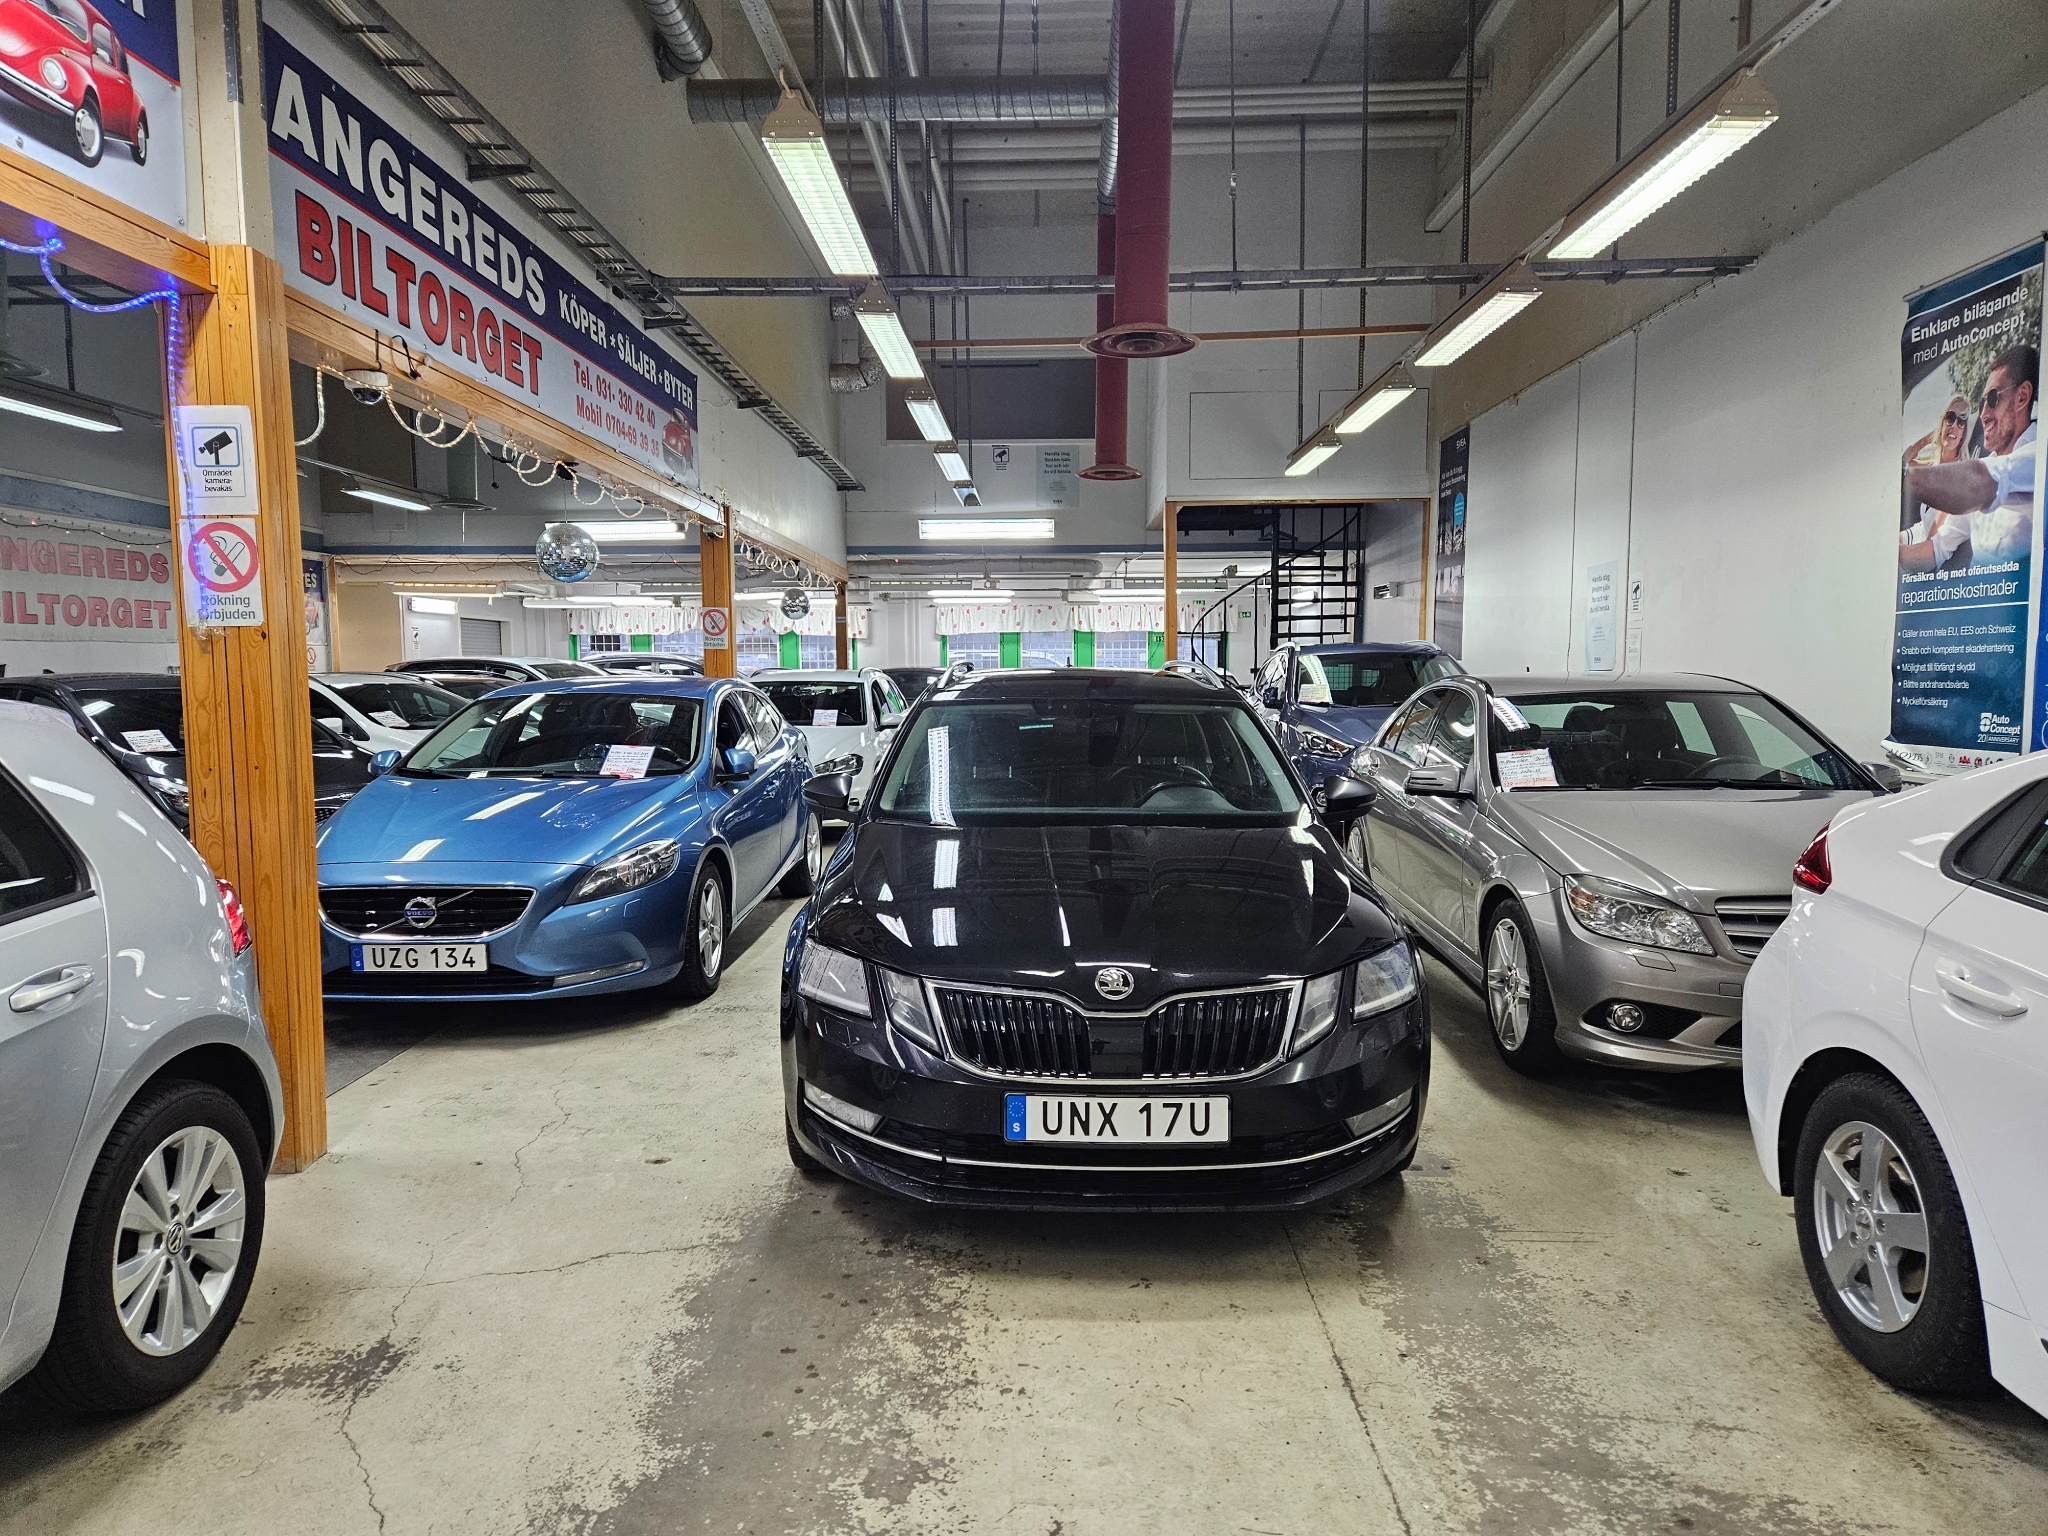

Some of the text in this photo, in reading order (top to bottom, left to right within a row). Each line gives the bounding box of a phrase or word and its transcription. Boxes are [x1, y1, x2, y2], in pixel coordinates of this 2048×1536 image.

[270, 64, 693, 411] ANGEREDS KÖPER SÄLJER BYTER
[294, 188, 543, 397] BILTORGET
[1911, 287, 2029, 343] Enklare bilägande
[1913, 311, 2025, 365] med AutoConcept
[573, 359, 593, 392] Tel.
[618, 388, 633, 416] 330
[634, 399, 645, 423] 42
[647, 407, 656, 430] 40
[576, 395, 660, 459] Mobil 0704-69 39 35
[202, 469, 233, 477] Området
[204, 484, 233, 492] bevakas
[0, 535, 170, 584] NGEREDS
[1901, 561, 2020, 584] Försäkra dig mot oförutsedda
[1901, 580, 2018, 606] reparationskostnader
[0, 590, 172, 629] ILTORGET
[1902, 623, 2017, 638] Gäller inom hela EU, EES och Schweiz
[1901, 643, 2015, 655] Snabb och kompetent skadehantering
[1901, 663, 1927, 673] Möjlighet
[1934, 662, 1956, 673] förlängt
[1956, 662, 1976, 673] skydd
[1903, 680, 1970, 689] Bättre andrahandsvärde
[1902, 696, 1948, 708] Nyckelförsäkring
[1989, 723, 2021, 735] Concept
[1991, 714, 2010, 724] Auto
[1977, 733, 1987, 743] 20
[371, 947, 419, 969] UZG
[430, 947, 476, 969] 134
[1012, 1100, 1211, 1137] S UNX 17U
